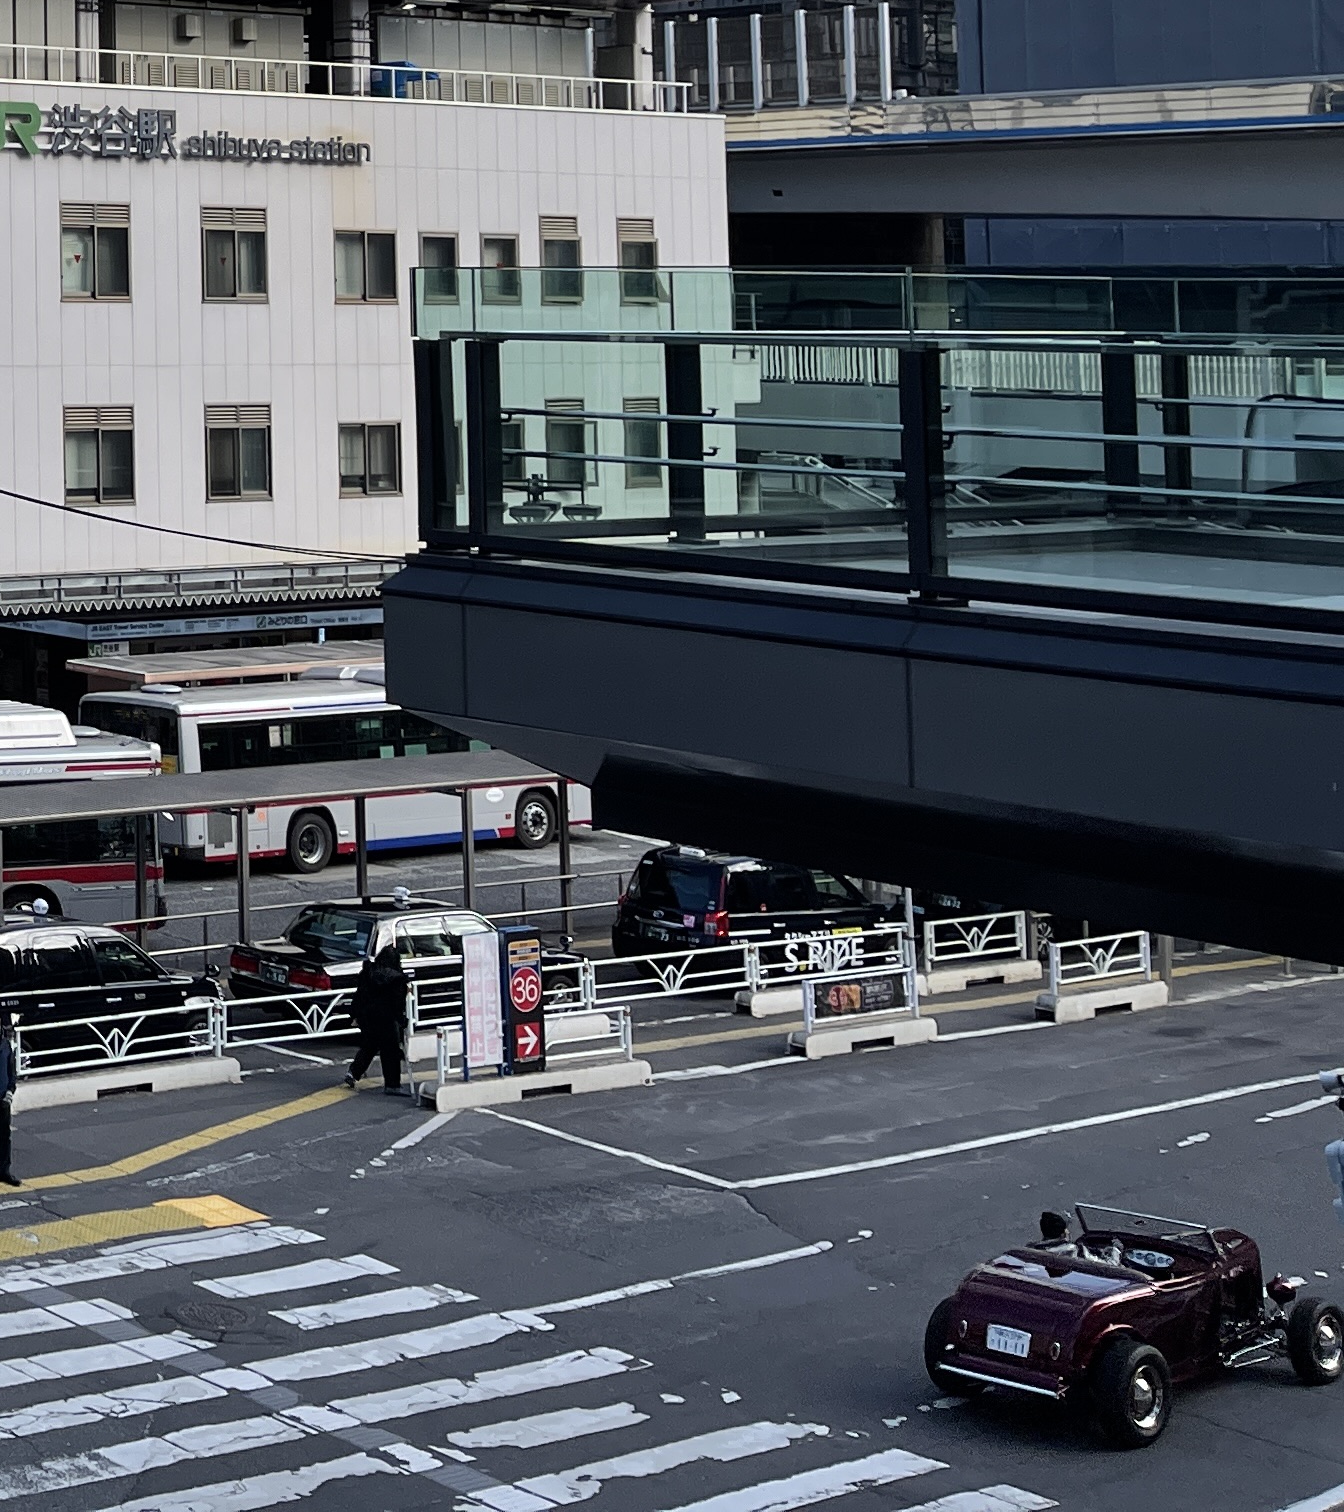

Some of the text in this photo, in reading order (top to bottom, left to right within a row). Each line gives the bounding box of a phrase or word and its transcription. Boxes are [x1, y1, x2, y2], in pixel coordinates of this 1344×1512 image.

[50, 103, 178, 160] 渋谷駅
[513, 975, 539, 1004] 36
